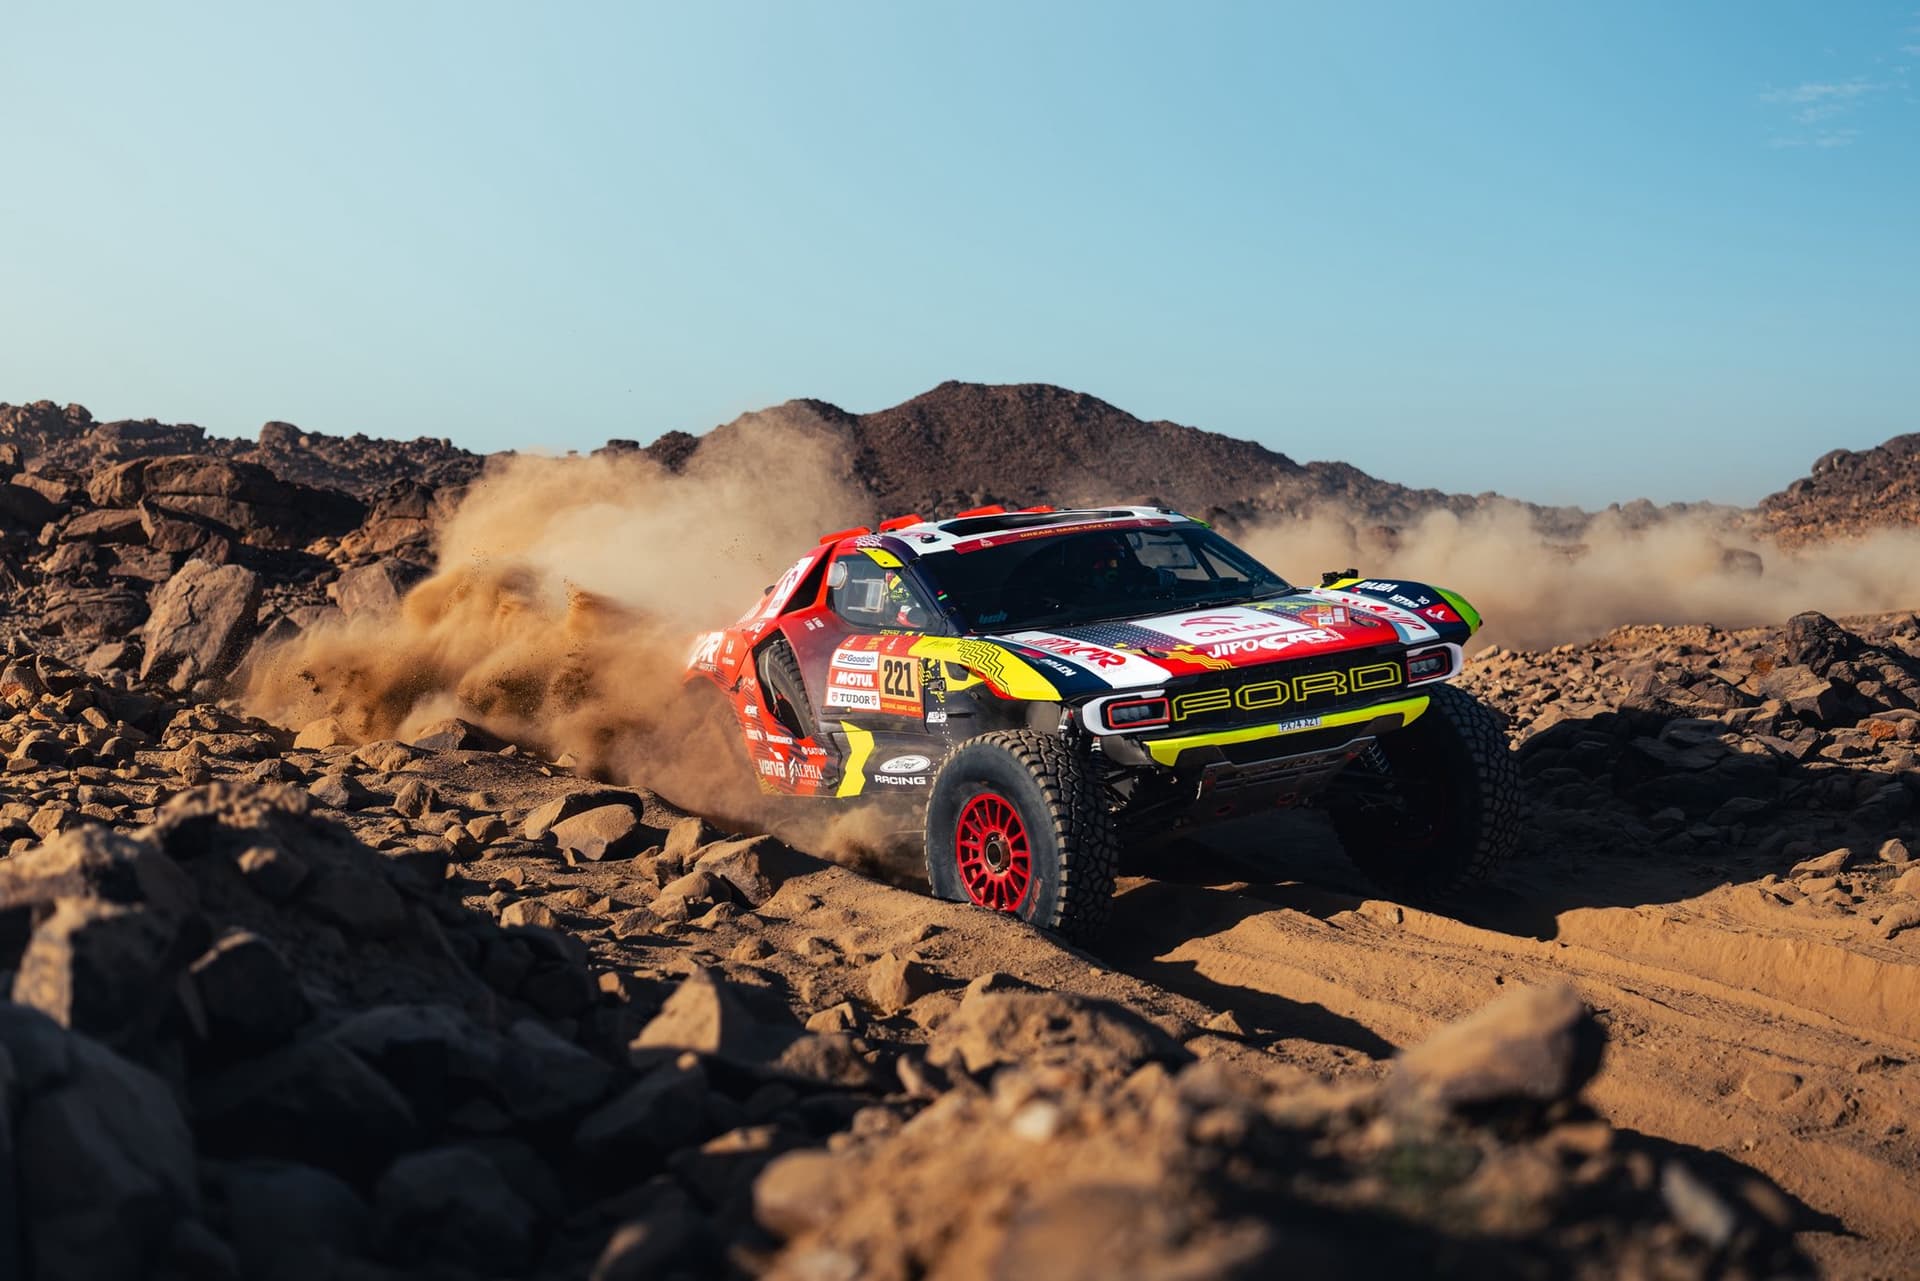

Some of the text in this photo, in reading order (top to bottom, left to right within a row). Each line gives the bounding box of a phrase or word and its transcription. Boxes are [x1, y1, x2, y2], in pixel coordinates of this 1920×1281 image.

[1195, 622, 1280, 638] ORLEN
[838, 652, 875, 664] BFGoodrich
[836, 671, 874, 687] MOTUL
[883, 659, 915, 698] 221
[839, 693, 871, 705] TUDOR
[1172, 661, 1402, 721] FORD
[794, 763, 823, 780] ALPHA
[874, 774, 926, 785] RACING
